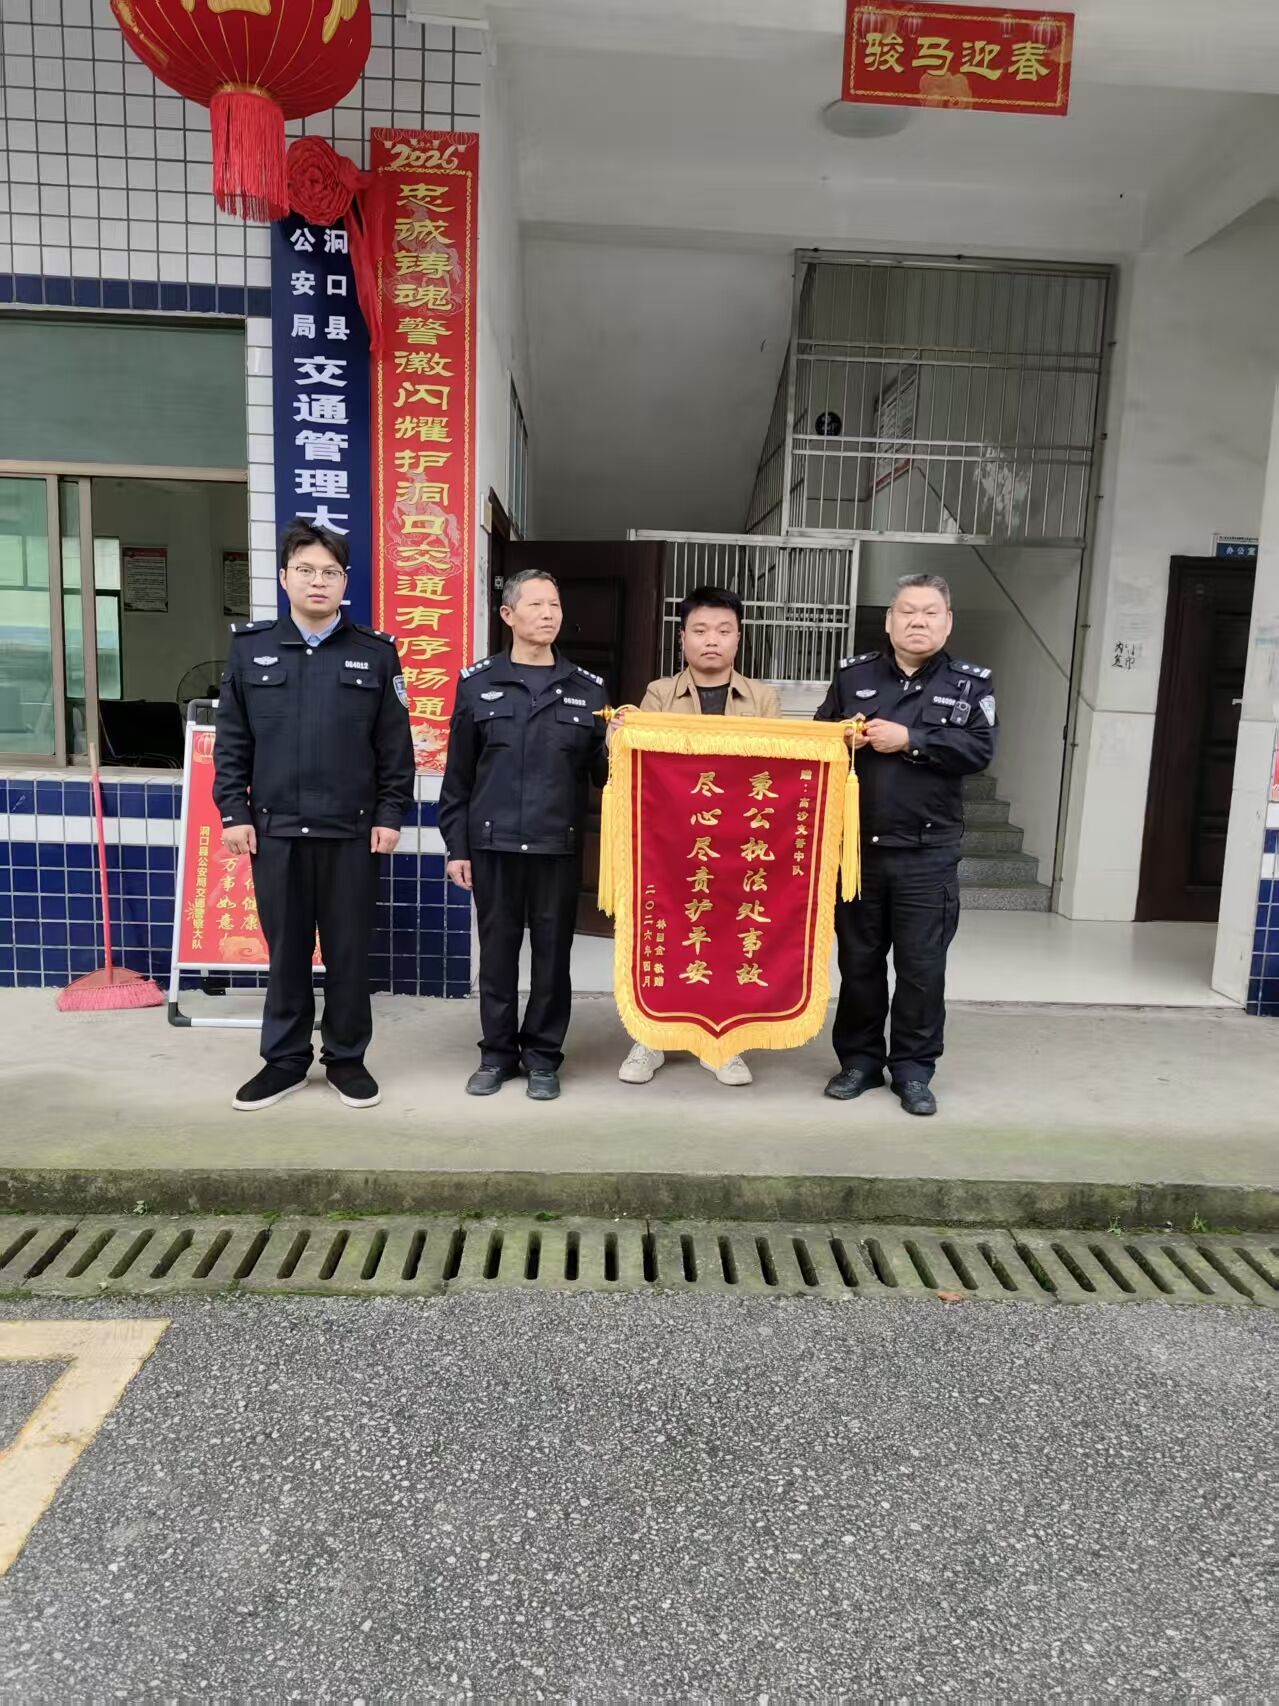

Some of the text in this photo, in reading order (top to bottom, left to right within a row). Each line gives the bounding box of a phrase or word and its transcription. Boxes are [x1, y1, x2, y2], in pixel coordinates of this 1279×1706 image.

[864, 31, 1052, 82] 骏马迎春
[390, 143, 459, 170] 2026
[290, 229, 316, 340] 公安局
[324, 229, 350, 342] 洞口县
[293, 355, 352, 606] 交通管理大
[393, 182, 456, 721] 忠诚铸魂警徽闪耀护洞口交通有序畅通
[678, 771, 725, 985] 尽心尽责护平安
[736, 770, 779, 987] 秉公执法处事故
